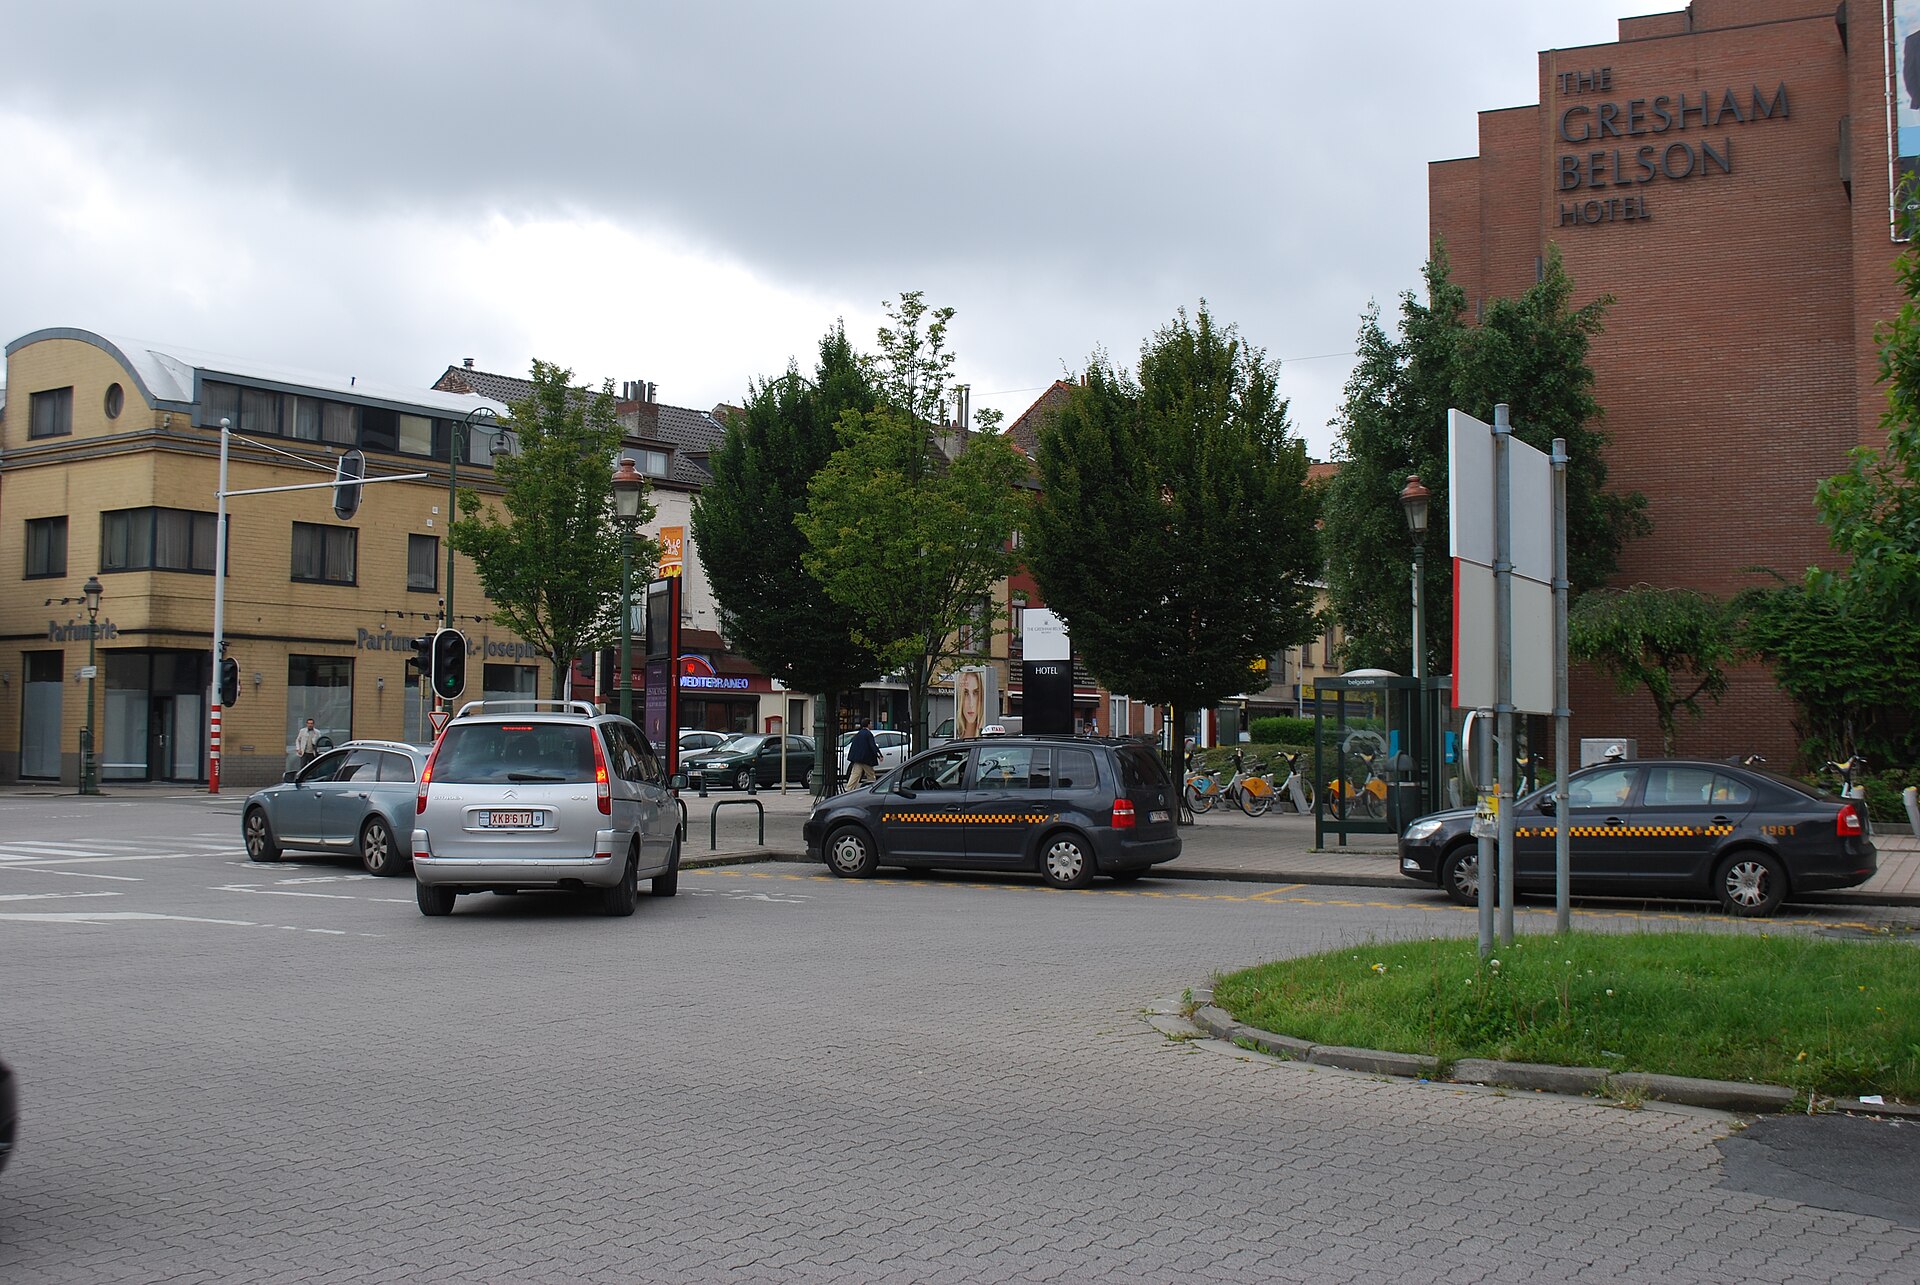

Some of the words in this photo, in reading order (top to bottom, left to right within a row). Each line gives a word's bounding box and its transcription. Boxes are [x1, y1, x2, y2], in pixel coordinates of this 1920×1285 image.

[1559, 67, 1612, 94] THE
[1559, 81, 1789, 142] GRESHAM
[1559, 137, 1731, 191] BELSON
[1559, 196, 1650, 226] HOTEL
[680, 676, 749, 689] MEDITERRANEO
[1035, 666, 1059, 675] HOTEL
[1760, 824, 1796, 837] 1981
